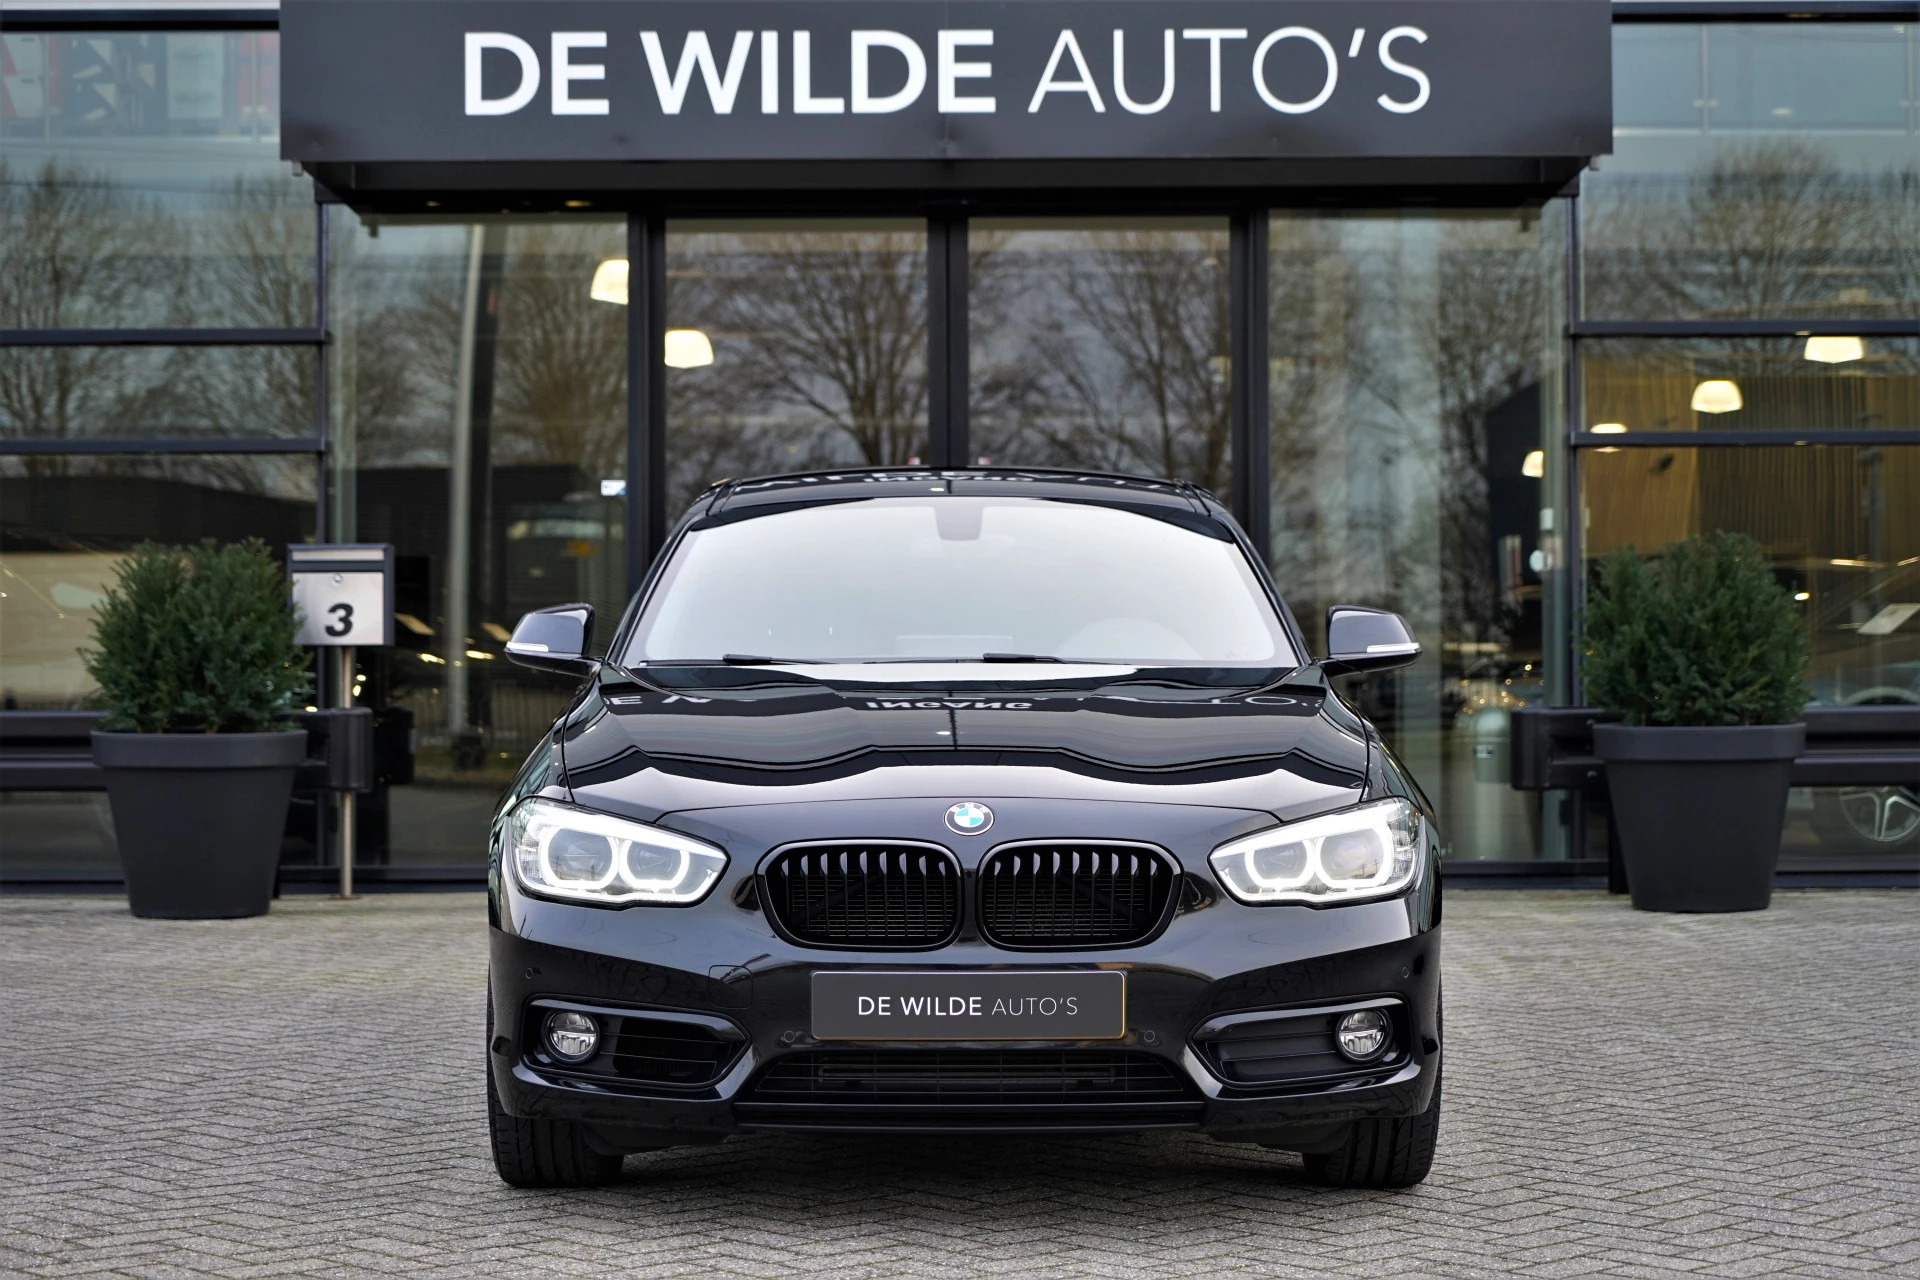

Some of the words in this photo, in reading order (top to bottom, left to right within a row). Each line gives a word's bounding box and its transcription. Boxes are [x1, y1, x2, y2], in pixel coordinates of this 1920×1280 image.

[464, 31, 610, 116] DE
[640, 29, 997, 115] WILDE
[1027, 26, 1431, 115] AUTO'S
[325, 603, 353, 637] 3
[858, 996, 891, 1016] DE
[900, 996, 982, 1016] WILDE
[991, 997, 1078, 1016] AUTO'S
